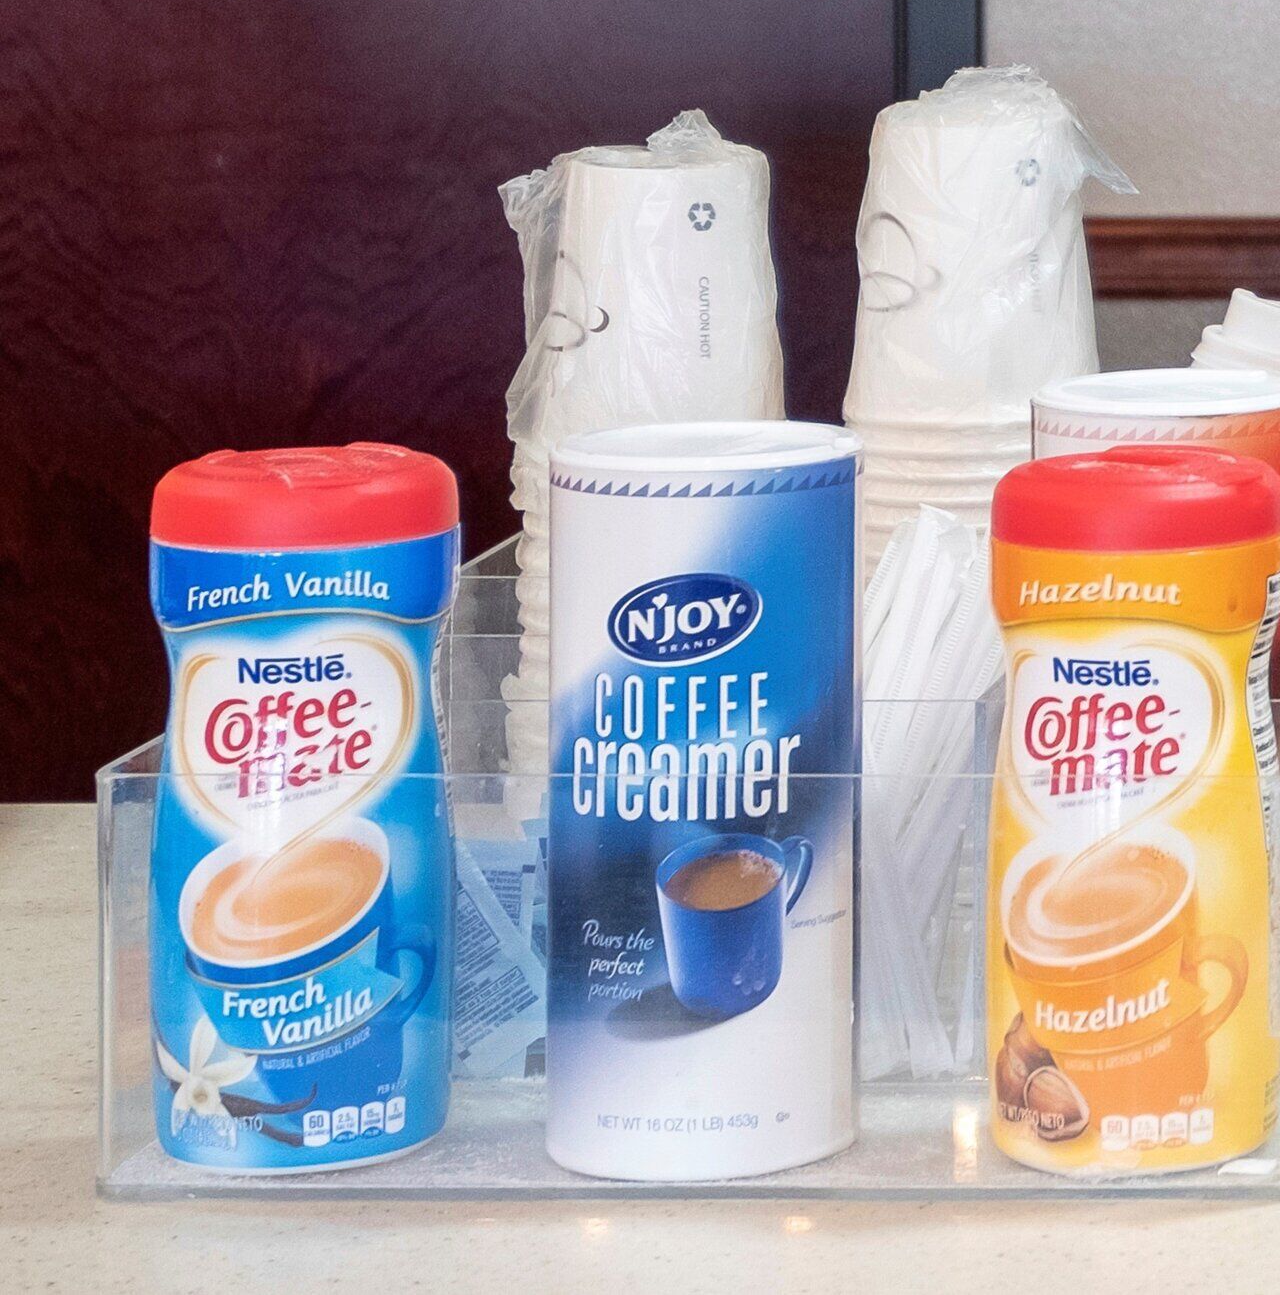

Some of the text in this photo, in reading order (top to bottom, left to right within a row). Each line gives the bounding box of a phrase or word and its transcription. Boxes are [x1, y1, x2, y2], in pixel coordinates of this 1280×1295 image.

[699, 276, 711, 359] CAUTION HOT
[187, 569, 391, 612] French Vanilla
[1019, 573, 1183, 606] Hazelnut
[657, 636, 718, 655] BRAND
[238, 654, 346, 685] Nestlé
[1052, 657, 1152, 687] Nestlé
[595, 671, 769, 741] COFFEE
[238, 728, 372, 799] mate
[572, 734, 801, 823] creamer
[1049, 734, 1181, 797] mate
[581, 918, 623, 950] Pours
[626, 926, 655, 952] the
[588, 951, 645, 980] perfect
[222, 976, 326, 1019] French
[587, 982, 644, 1002] portion
[1034, 978, 1170, 1034] Hazelnut
[261, 987, 374, 1048] Vanilla
[308, 1114, 324, 1129] 60
[596, 1113, 620, 1130] NET
[622, 1117, 641, 1132] WT
[663, 1117, 684, 1133] OZ
[701, 1115, 725, 1134] LB)
[727, 1114, 760, 1131] 453g
